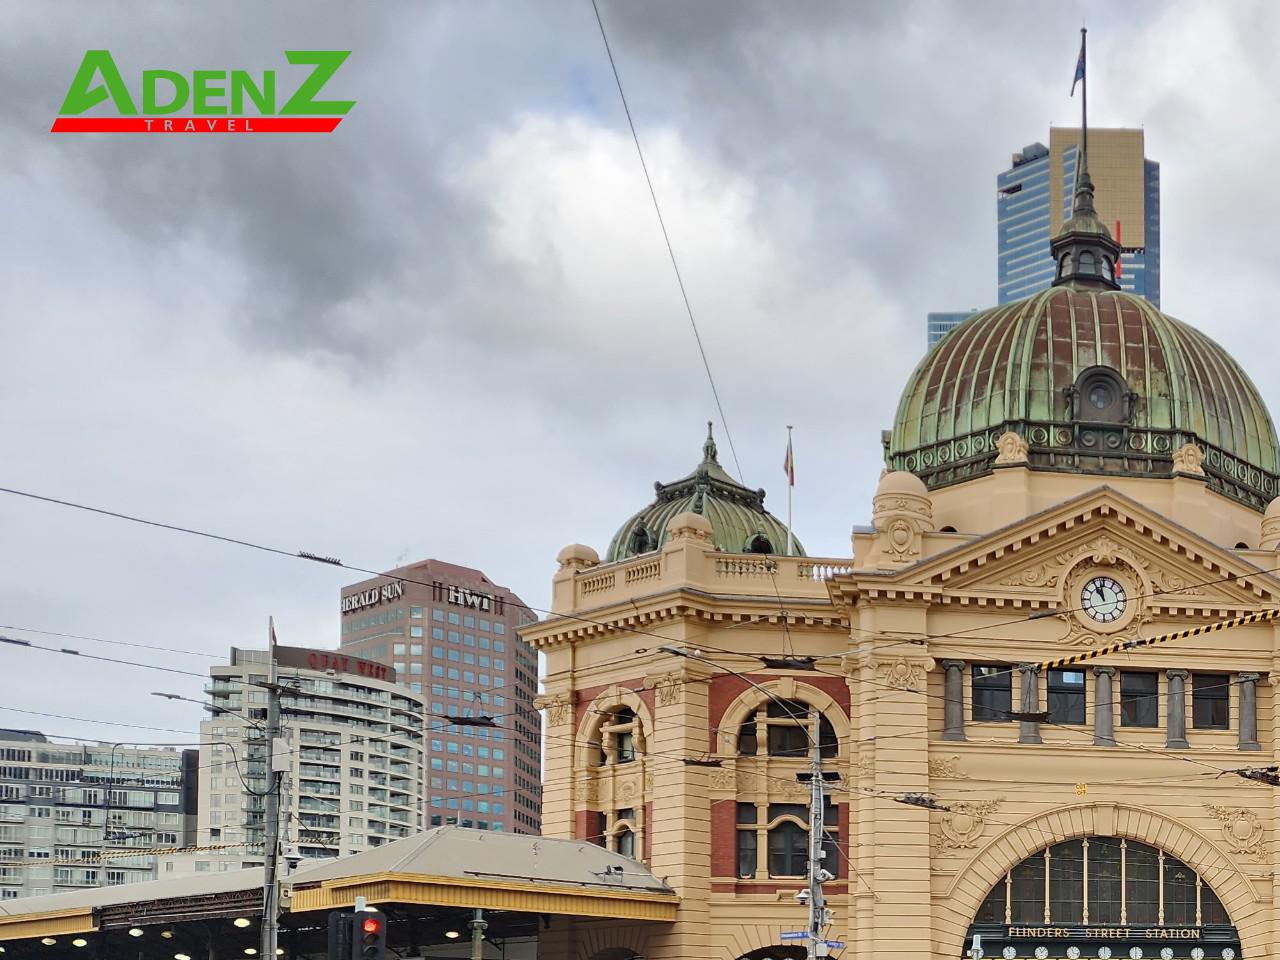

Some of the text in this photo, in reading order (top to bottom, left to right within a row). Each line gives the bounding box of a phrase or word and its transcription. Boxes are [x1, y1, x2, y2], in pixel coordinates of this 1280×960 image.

[382, 582, 403, 601] SUN
[308, 653, 387, 680] QUAY WEST
[1008, 927, 1200, 939] FLINDERS STREET STATION
